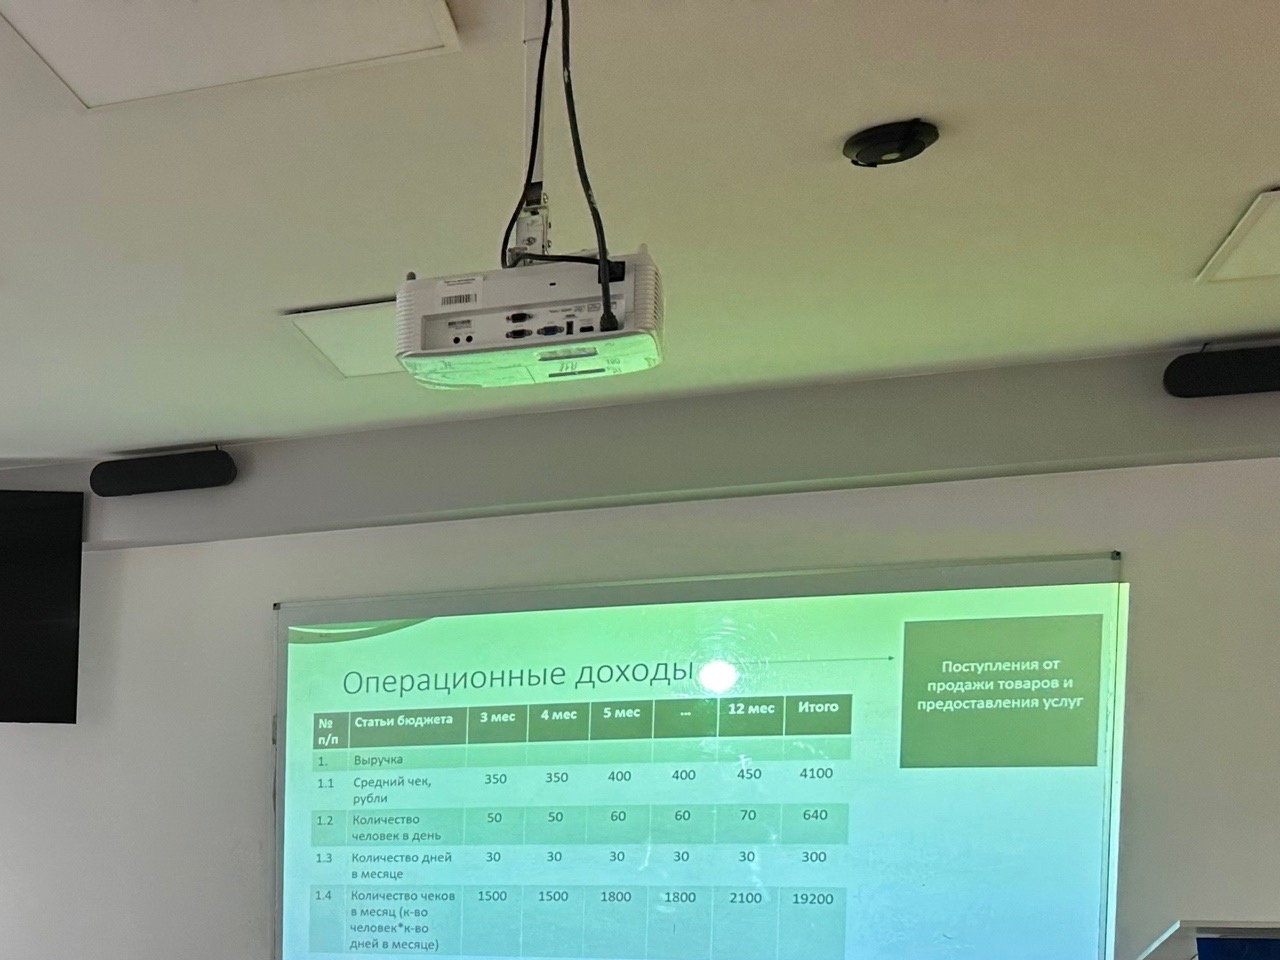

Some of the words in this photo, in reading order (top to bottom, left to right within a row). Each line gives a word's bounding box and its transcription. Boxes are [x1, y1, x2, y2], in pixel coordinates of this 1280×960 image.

[942, 660, 1039, 674] Поступления
[1043, 660, 1060, 670] от
[343, 666, 566, 697] Операционные
[575, 662, 694, 689] доходы
[928, 680, 994, 693] продажи
[998, 679, 1059, 691] товаров
[1063, 678, 1073, 688] и
[918, 698, 1039, 712] предоставления
[1043, 697, 1083, 710] услуг
[319, 718, 333, 729] №
[354, 716, 394, 727] Статьи
[397, 715, 453, 727] бюджета
[480, 712, 488, 722] 3
[491, 713, 516, 722] мес
[540, 710, 549, 720] 4
[552, 711, 578, 720] мес
[603, 708, 612, 718] 5
[614, 708, 641, 718] мес
[728, 703, 745, 715] 12
[748, 704, 775, 714] мес
[798, 701, 839, 713] Итого
[318, 734, 338, 745] п/п
[318, 757, 328, 766] 1.
[354, 755, 403, 767] Выручка
[318, 779, 334, 788] 1.1
[353, 777, 405, 788] Средний
[408, 777, 432, 787] чек,
[484, 774, 507, 784] 350
[546, 772, 568, 783] 350
[608, 771, 632, 782] 400
[672, 769, 696, 781] 400
[737, 768, 762, 780] 450
[800, 767, 833, 779] 4100
[353, 794, 387, 805] рубли
[317, 816, 334, 826] 1.2
[352, 815, 420, 825] Количество
[487, 813, 502, 823] 50
[548, 812, 564, 822] 50
[610, 811, 627, 822] 60
[674, 810, 691, 821] 60
[740, 810, 756, 821] 70
[803, 809, 828, 821] 640
[352, 832, 399, 841] человек
[412, 832, 441, 843] день
[316, 854, 332, 863] 1.3
[351, 853, 419, 862] Количество
[421, 852, 452, 864] дней
[486, 852, 501, 862] 30
[547, 852, 562, 862] 30
[609, 852, 625, 862] 30
[673, 851, 689, 862] 30
[739, 851, 755, 862] 30
[801, 852, 827, 862] 300
[360, 871, 403, 880] месяце
[315, 891, 332, 900] 1.4
[351, 891, 418, 900] Количество
[421, 893, 456, 901] чеков
[478, 891, 507, 901] 1500
[538, 890, 568, 901] 1500
[601, 891, 631, 902] 1800
[665, 892, 696, 903] 1800
[730, 892, 762, 904] 2100
[792, 893, 834, 905] 19200
[351, 908, 357, 916] в
[360, 908, 396, 918] месяц
[399, 906, 428, 919] (к-во
[349, 939, 378, 950] дней
[382, 941, 389, 949] в
[392, 940, 439, 951] месяце)
